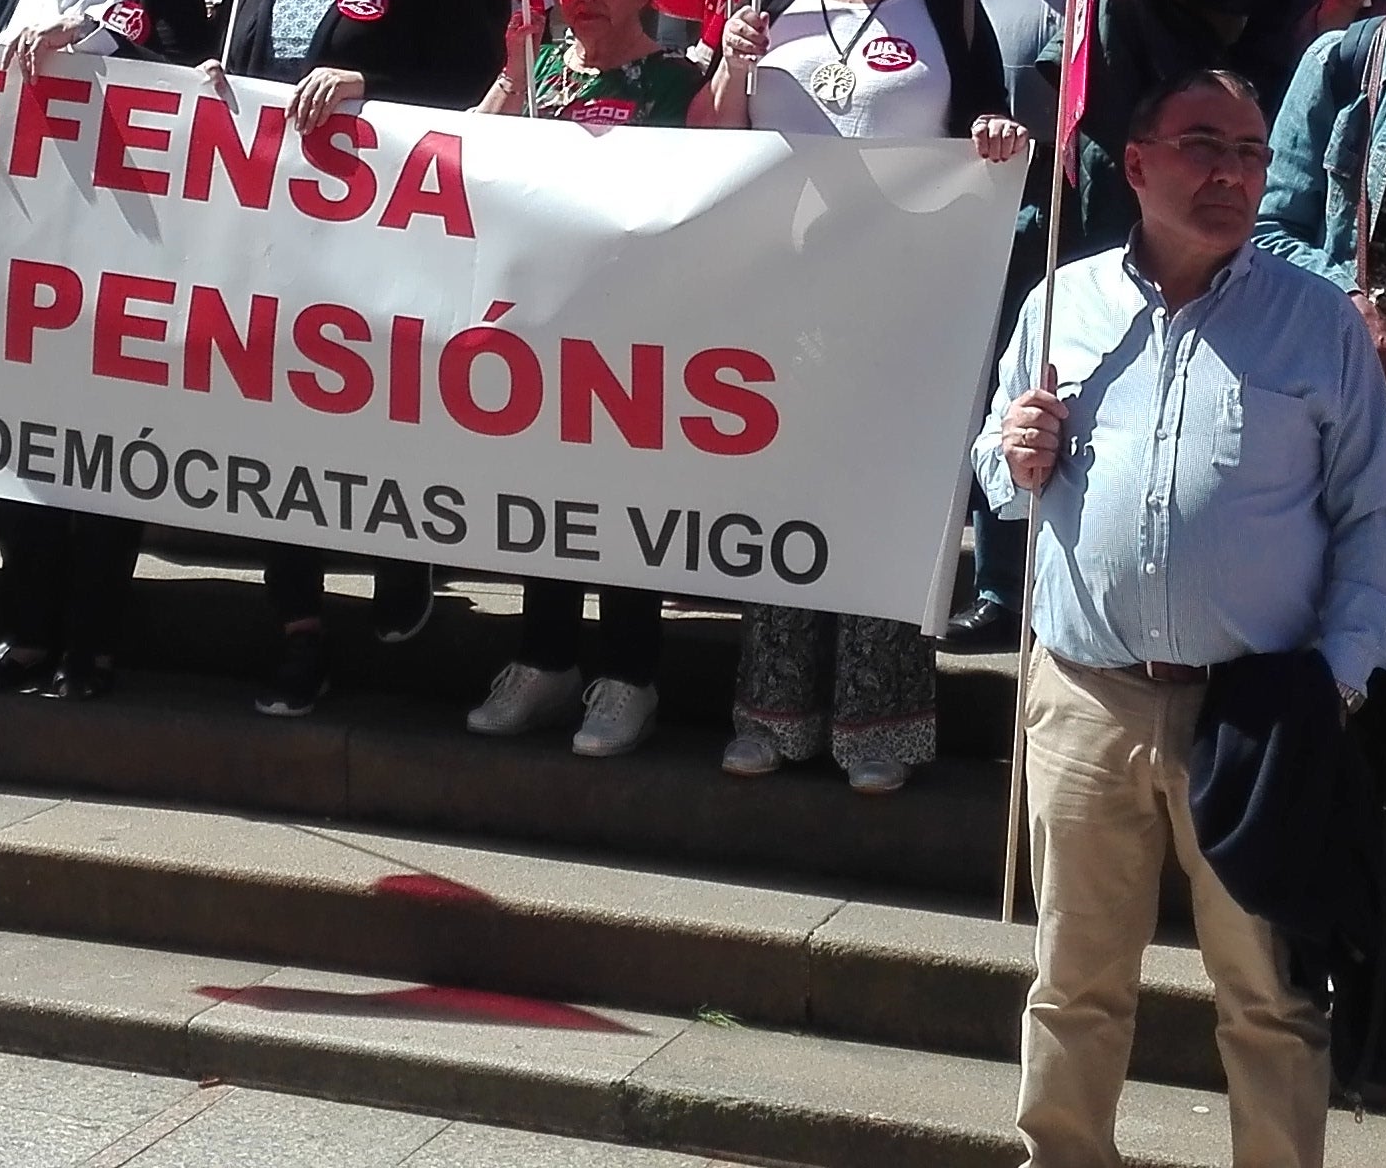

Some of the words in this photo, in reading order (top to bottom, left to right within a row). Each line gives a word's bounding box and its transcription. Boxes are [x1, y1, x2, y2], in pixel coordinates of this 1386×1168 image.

[571, 106, 630, 121] CCOO
[4, 259, 780, 456] PENSIÓNS
[496, 493, 601, 563] DE
[627, 506, 830, 586] VIGO
